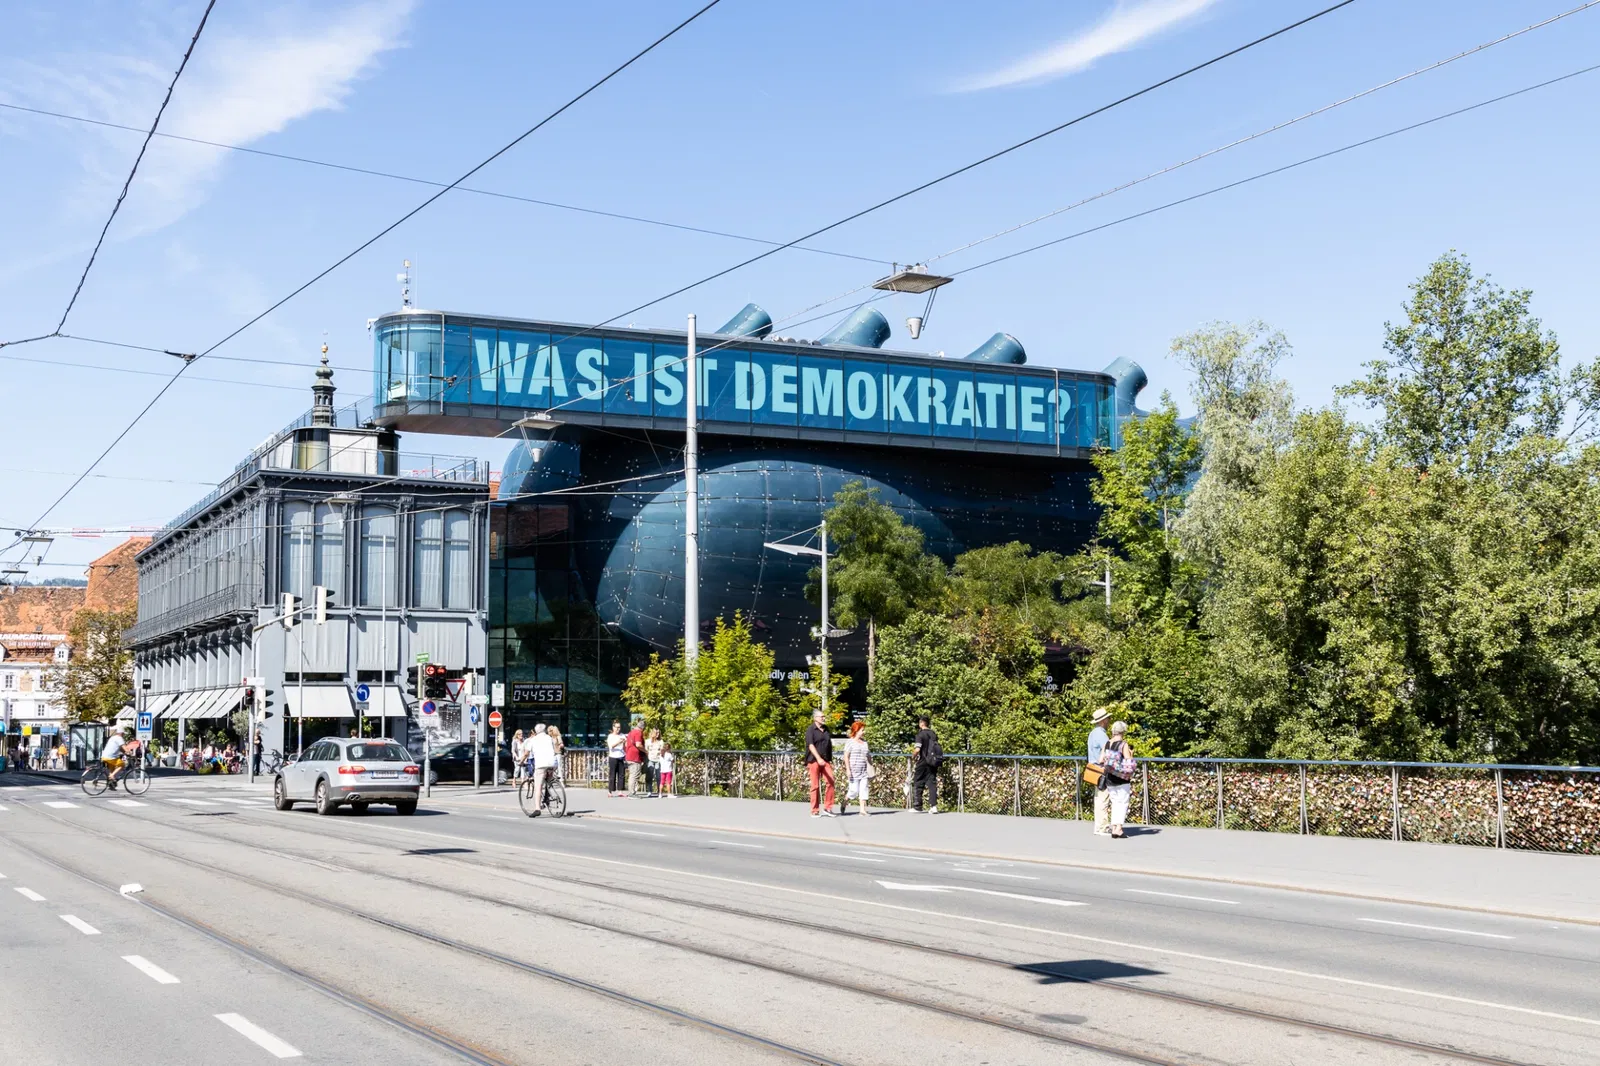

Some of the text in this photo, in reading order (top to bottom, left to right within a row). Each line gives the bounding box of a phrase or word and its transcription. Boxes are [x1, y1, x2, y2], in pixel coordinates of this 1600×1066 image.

[475, 339, 1071, 434] WAS IST DEMOKRATIE?
[513, 690, 563, 701] 044553
